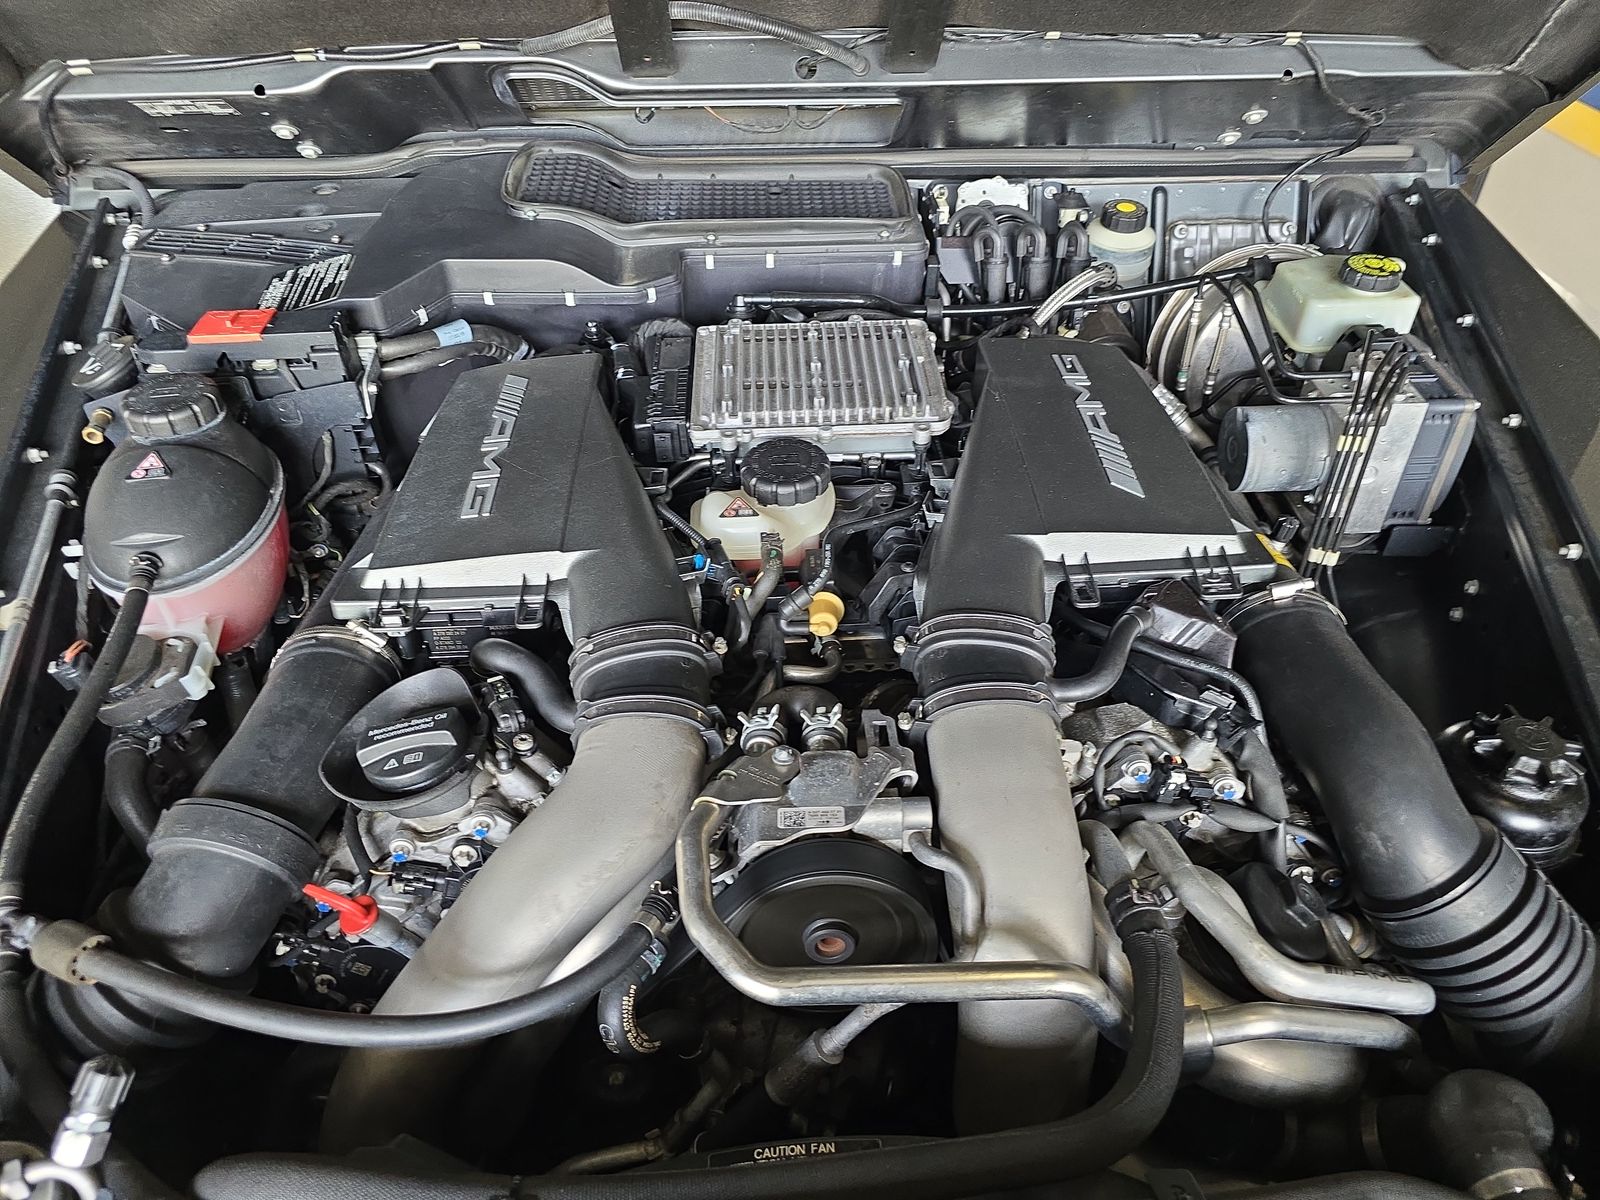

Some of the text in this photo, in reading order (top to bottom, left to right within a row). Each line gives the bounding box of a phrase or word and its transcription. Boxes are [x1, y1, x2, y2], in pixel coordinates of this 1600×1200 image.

[368, 712, 448, 737] Mercedes-Benz Oil
[373, 721, 435, 741] recommended
[753, 1142, 836, 1160] CAUTION FAN
